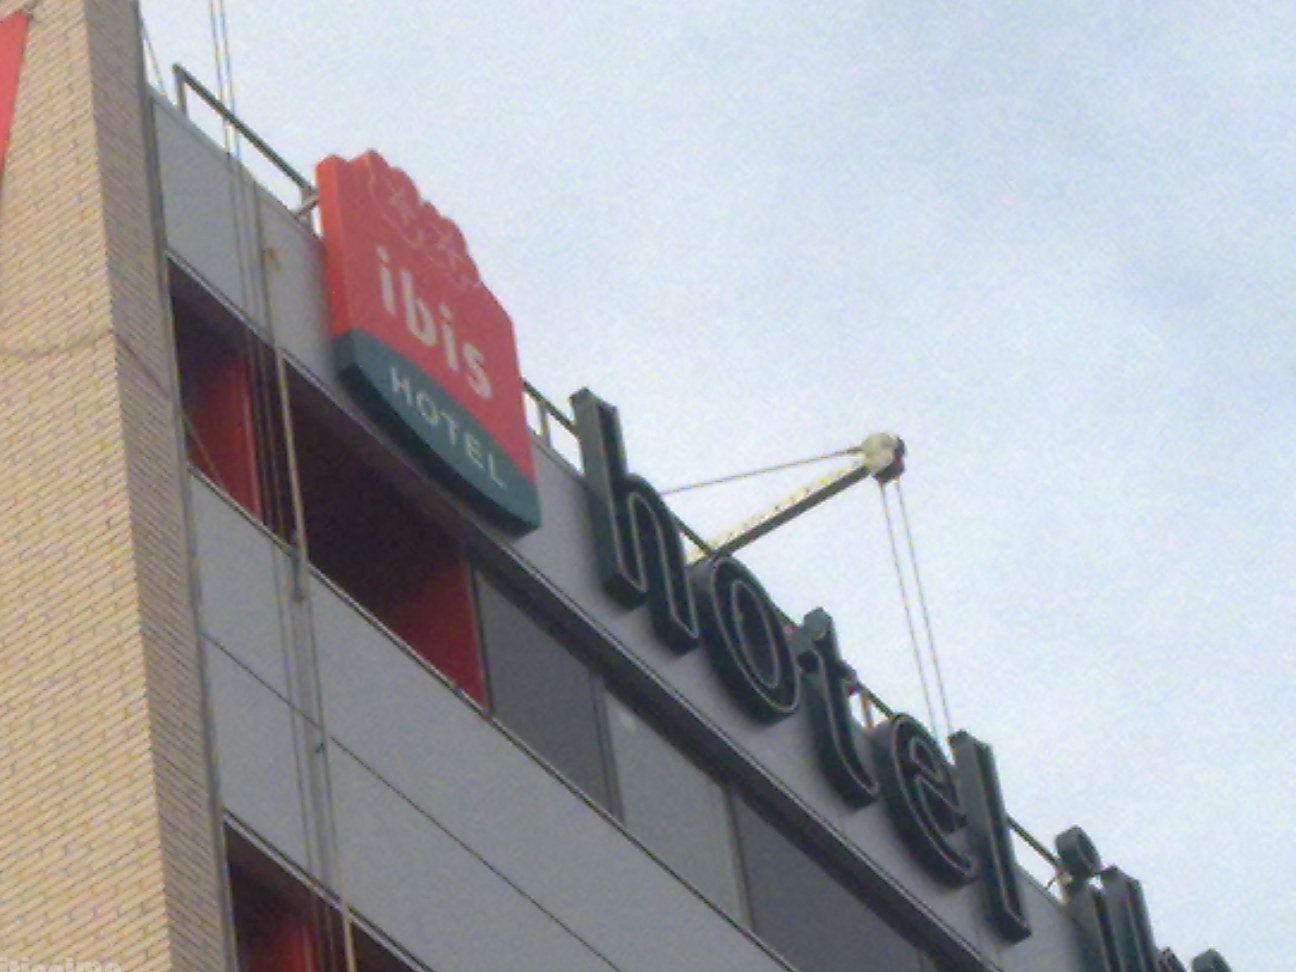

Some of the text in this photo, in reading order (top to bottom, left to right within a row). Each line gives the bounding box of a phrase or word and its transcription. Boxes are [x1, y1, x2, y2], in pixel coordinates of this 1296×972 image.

[376, 246, 493, 400] ibis
[390, 366, 506, 488] HOTEL
[570, 387, 1032, 942] hotel
